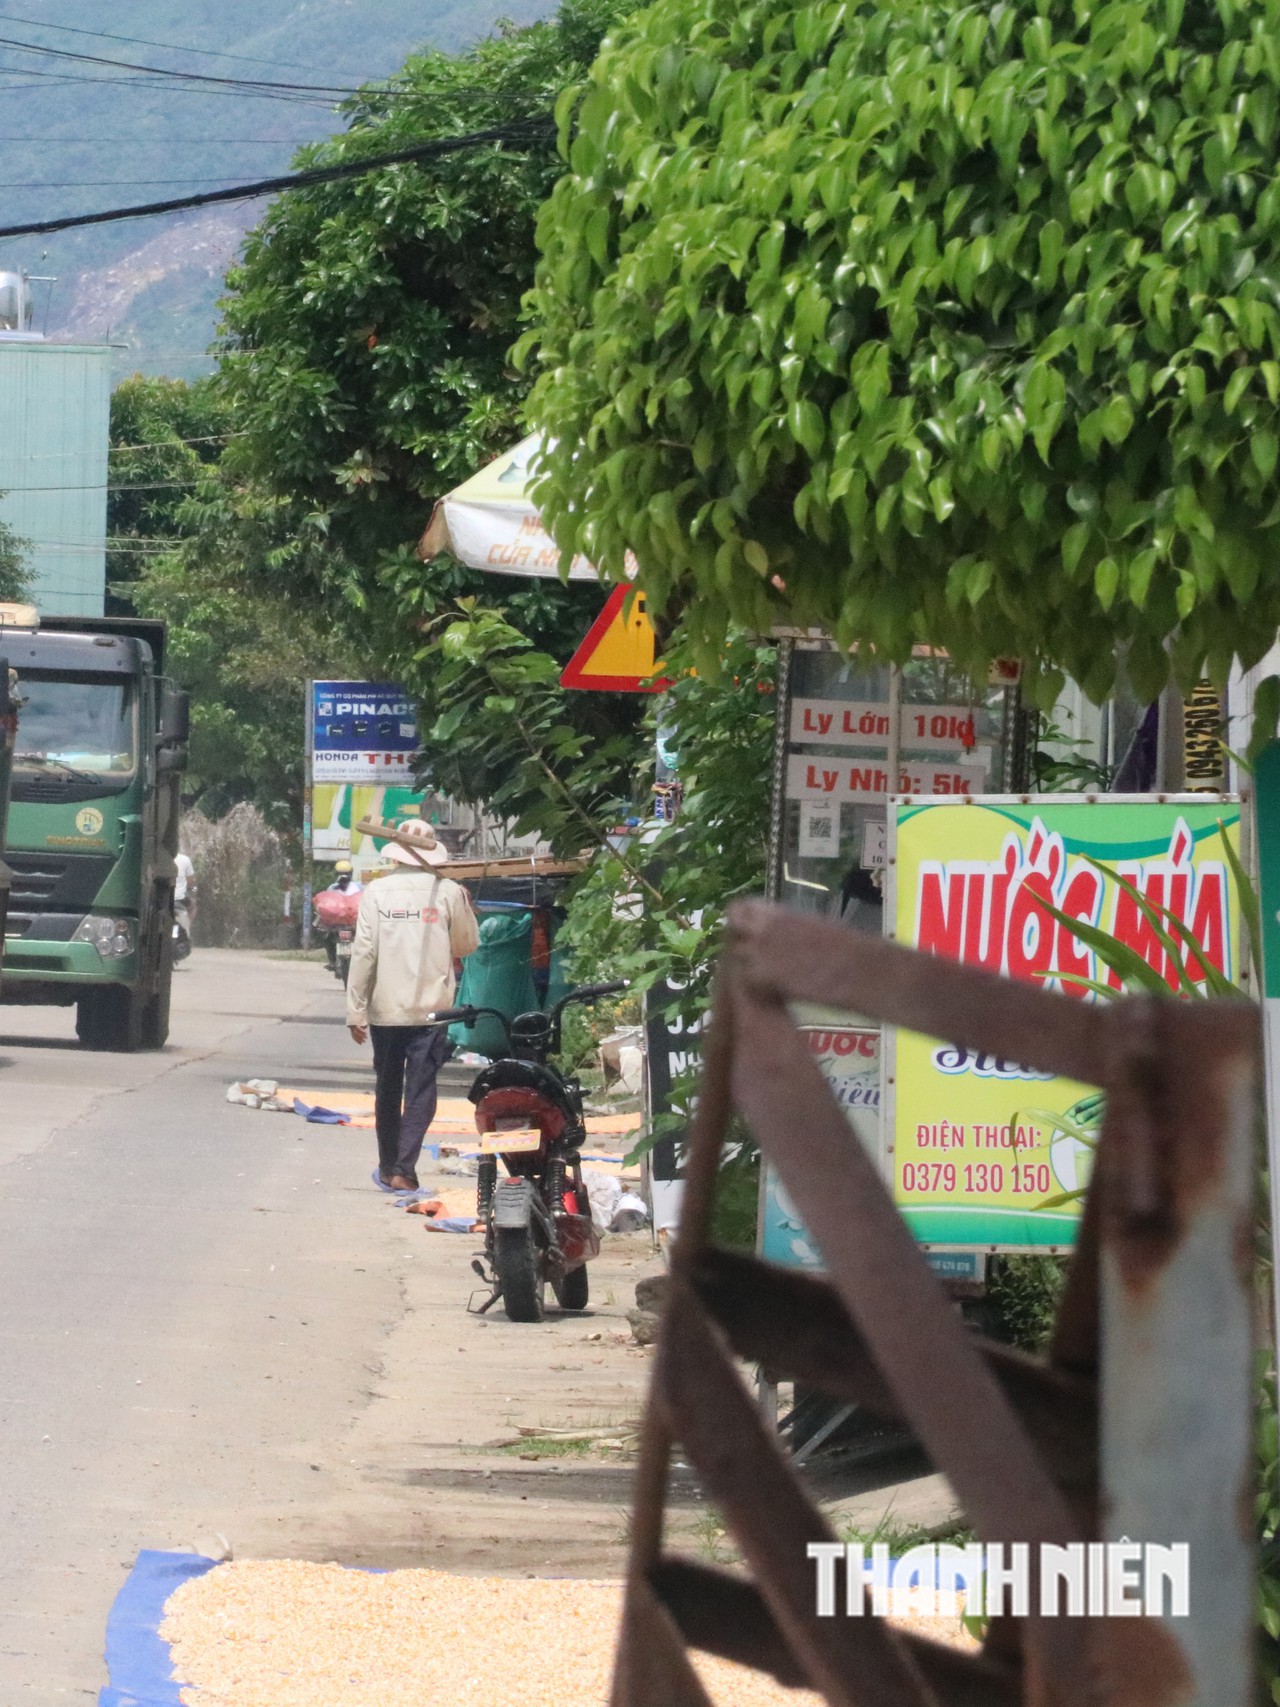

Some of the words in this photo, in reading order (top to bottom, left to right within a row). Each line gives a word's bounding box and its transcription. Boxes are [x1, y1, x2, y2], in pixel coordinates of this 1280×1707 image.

[803, 708, 833, 735] Ly
[315, 753, 359, 762] HONDA
[806, 765, 839, 792] Ly
[932, 773, 970, 794] 5k
[917, 828, 1098, 1000] NƯỚC
[1106, 829, 1227, 997] MÍA
[916, 1120, 964, 1152] ĐIỆN
[972, 1125, 1042, 1152] THOẠI:
[902, 1162, 956, 1192] 0379
[963, 1163, 1004, 1193] 130
[1010, 1164, 1050, 1193] 150
